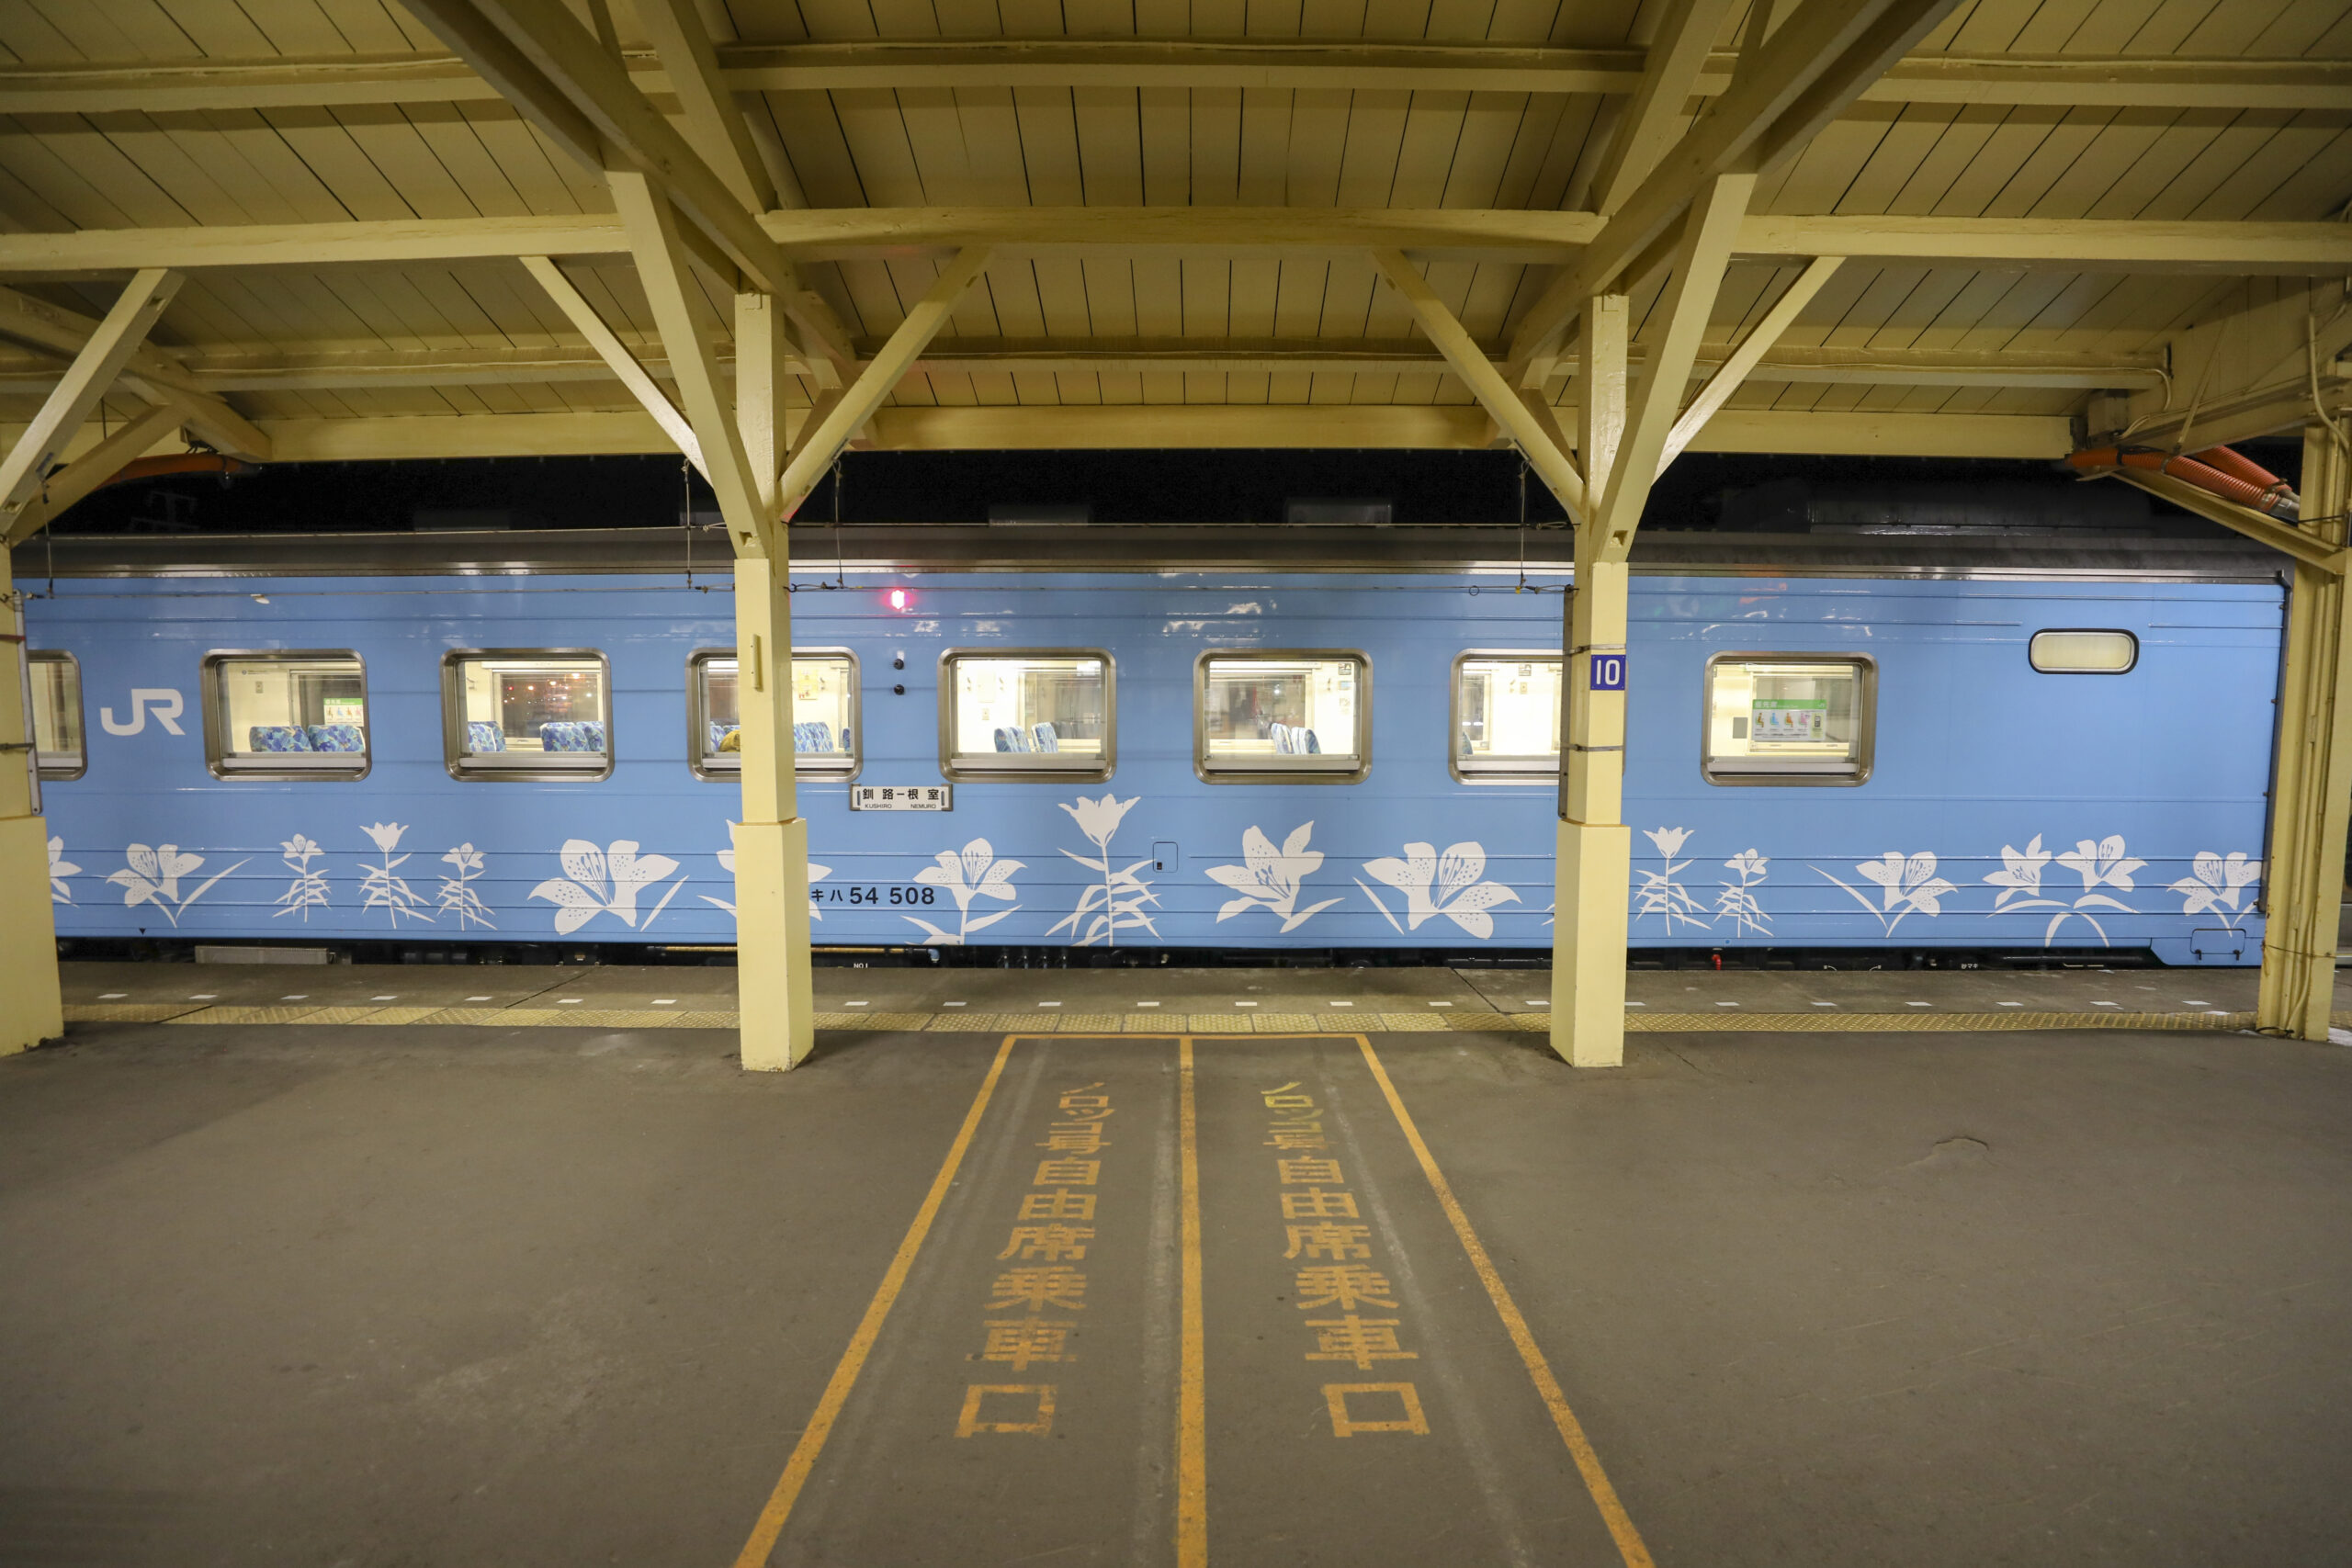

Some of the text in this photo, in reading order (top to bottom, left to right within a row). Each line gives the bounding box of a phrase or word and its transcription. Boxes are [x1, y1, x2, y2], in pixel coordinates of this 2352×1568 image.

[1596, 659, 1620, 685] 10
[100, 688, 186, 736] JR
[811, 886, 935, 905] キハ 54 508
